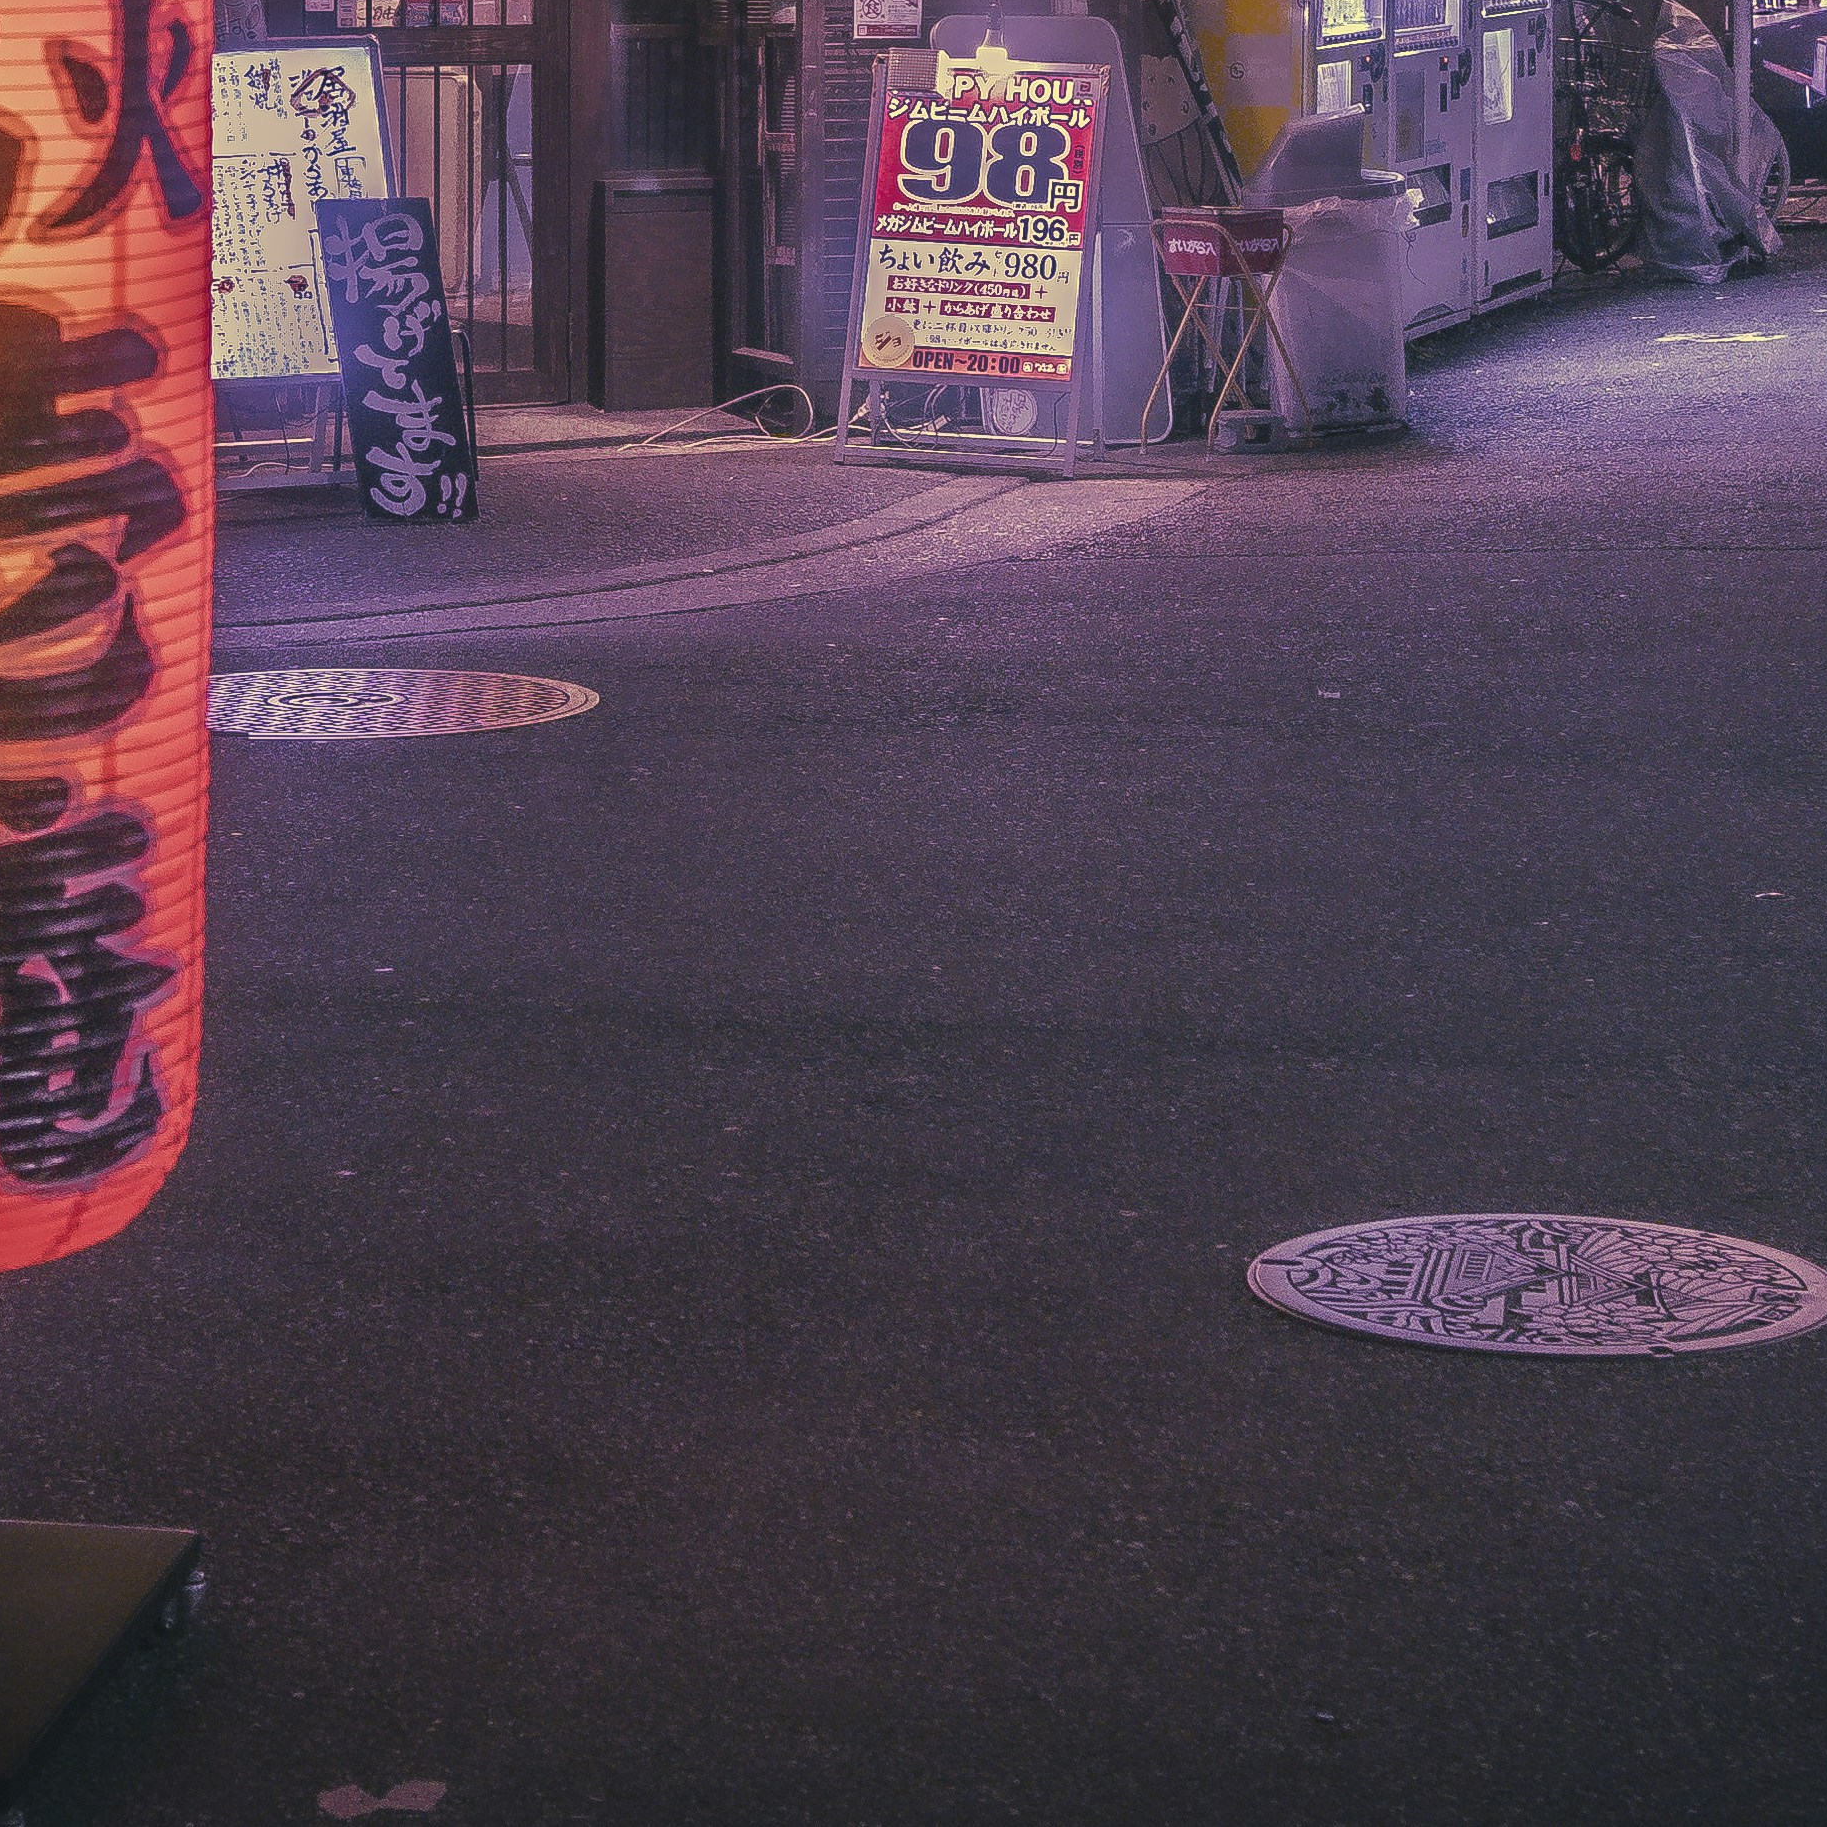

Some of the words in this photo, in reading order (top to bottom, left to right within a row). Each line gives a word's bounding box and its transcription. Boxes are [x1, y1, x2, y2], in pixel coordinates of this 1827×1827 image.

[887, 97, 1091, 129] ジムビームハイボール
[875, 215, 1018, 239] メガジムビームハイボール
[1019, 216, 1069, 243] 196
[878, 243, 991, 277] ちょい飲み
[1004, 251, 1058, 281] 980
[943, 302, 1053, 321] からあげ盛り合わせ
